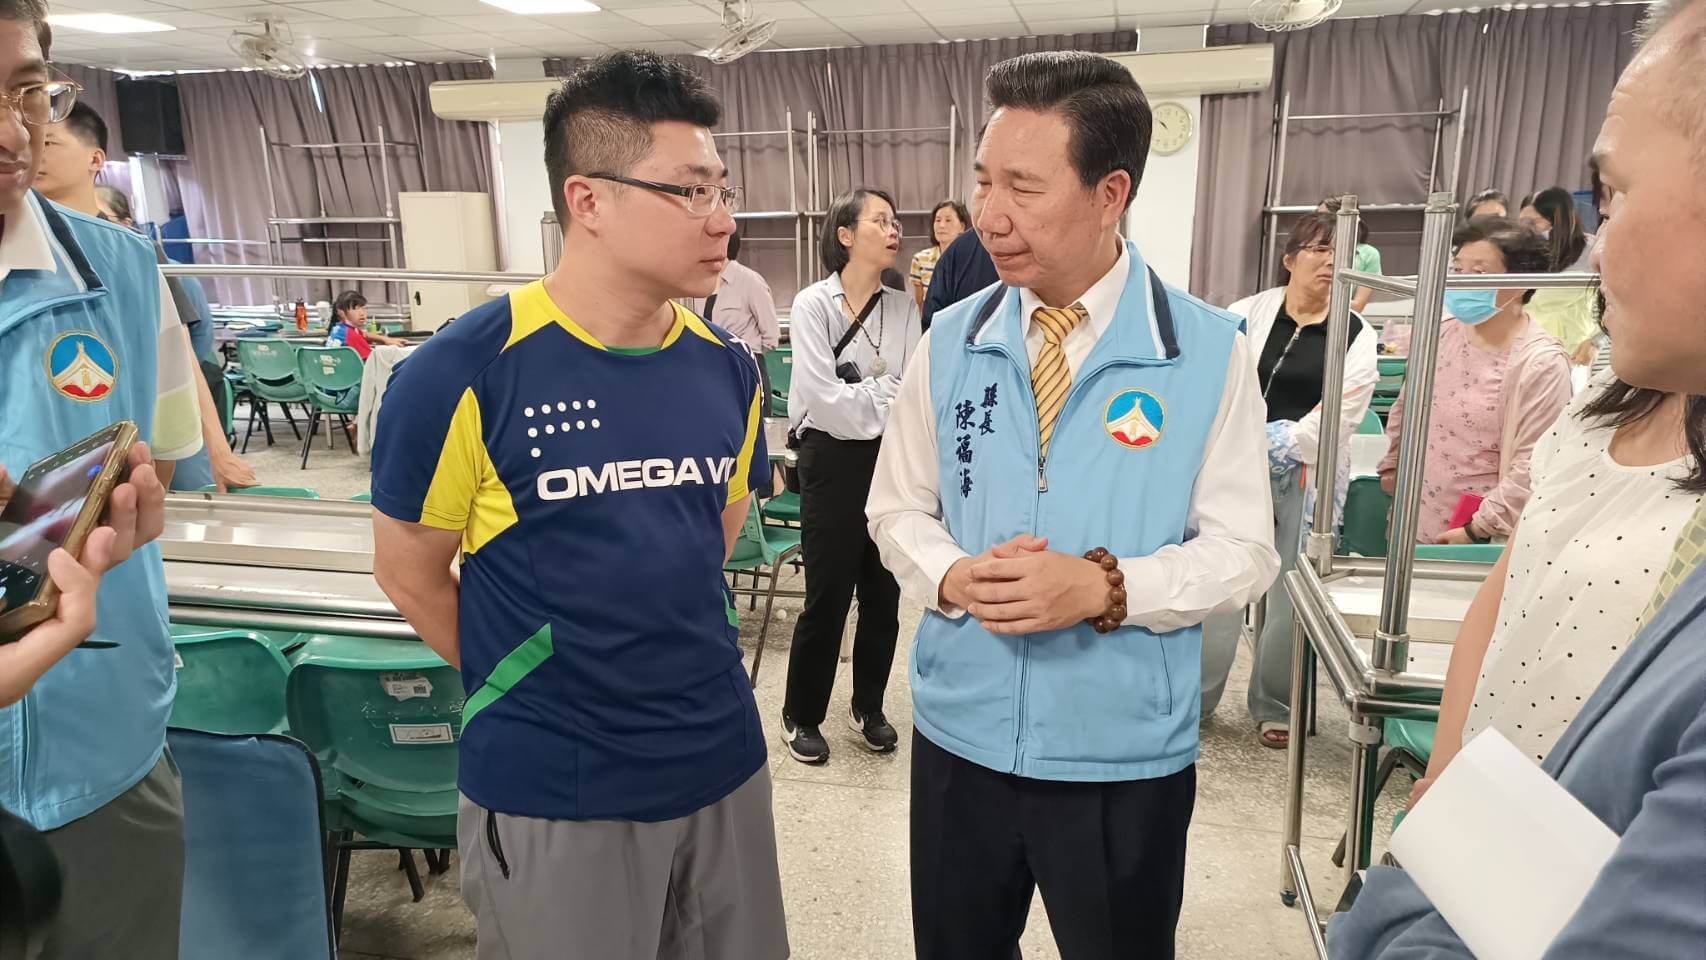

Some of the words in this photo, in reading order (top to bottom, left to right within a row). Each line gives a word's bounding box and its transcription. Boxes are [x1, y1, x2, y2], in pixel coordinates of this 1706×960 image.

[537, 457, 704, 500] OMEGA
[954, 399, 975, 498] 陳福海
